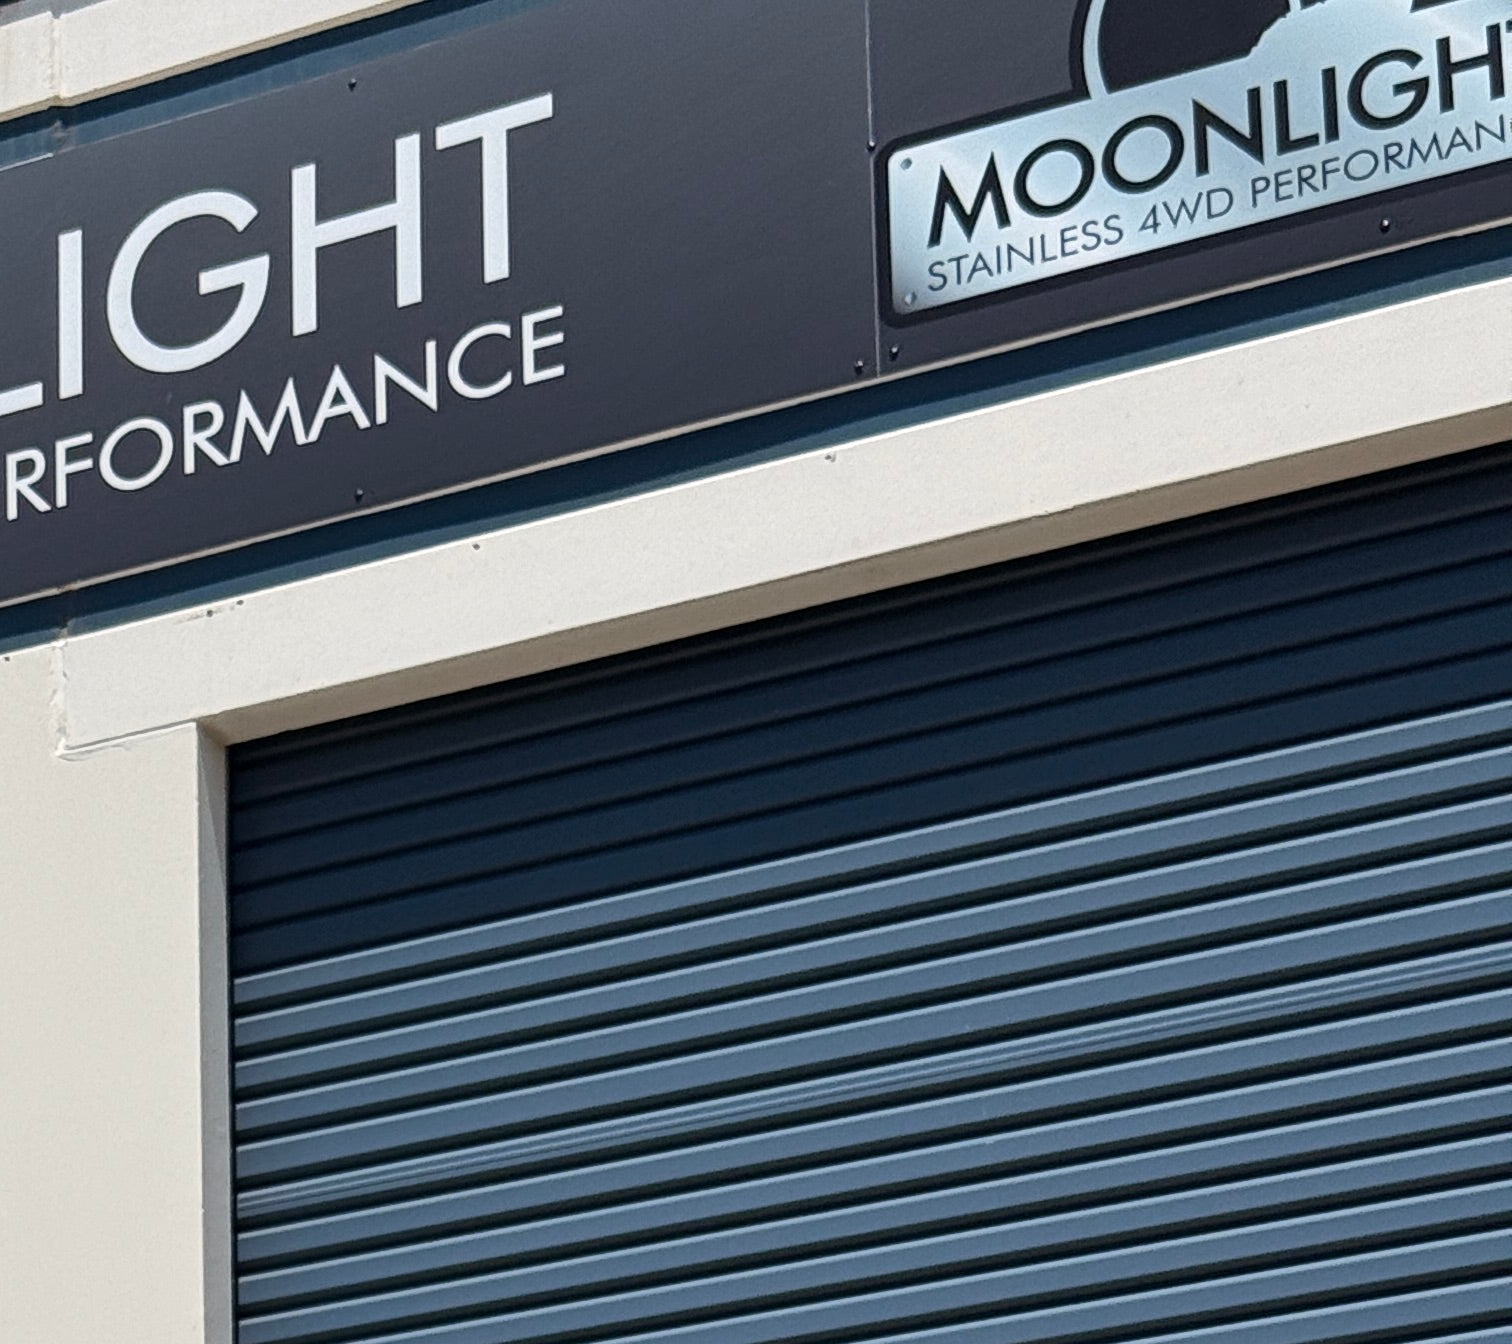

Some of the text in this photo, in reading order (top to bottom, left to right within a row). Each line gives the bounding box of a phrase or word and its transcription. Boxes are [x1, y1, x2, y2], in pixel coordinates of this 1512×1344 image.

[926, 19, 1512, 249] MOONLIGH
[927, 114, 1512, 292] STAINLESS 4WD PERFORMAN
